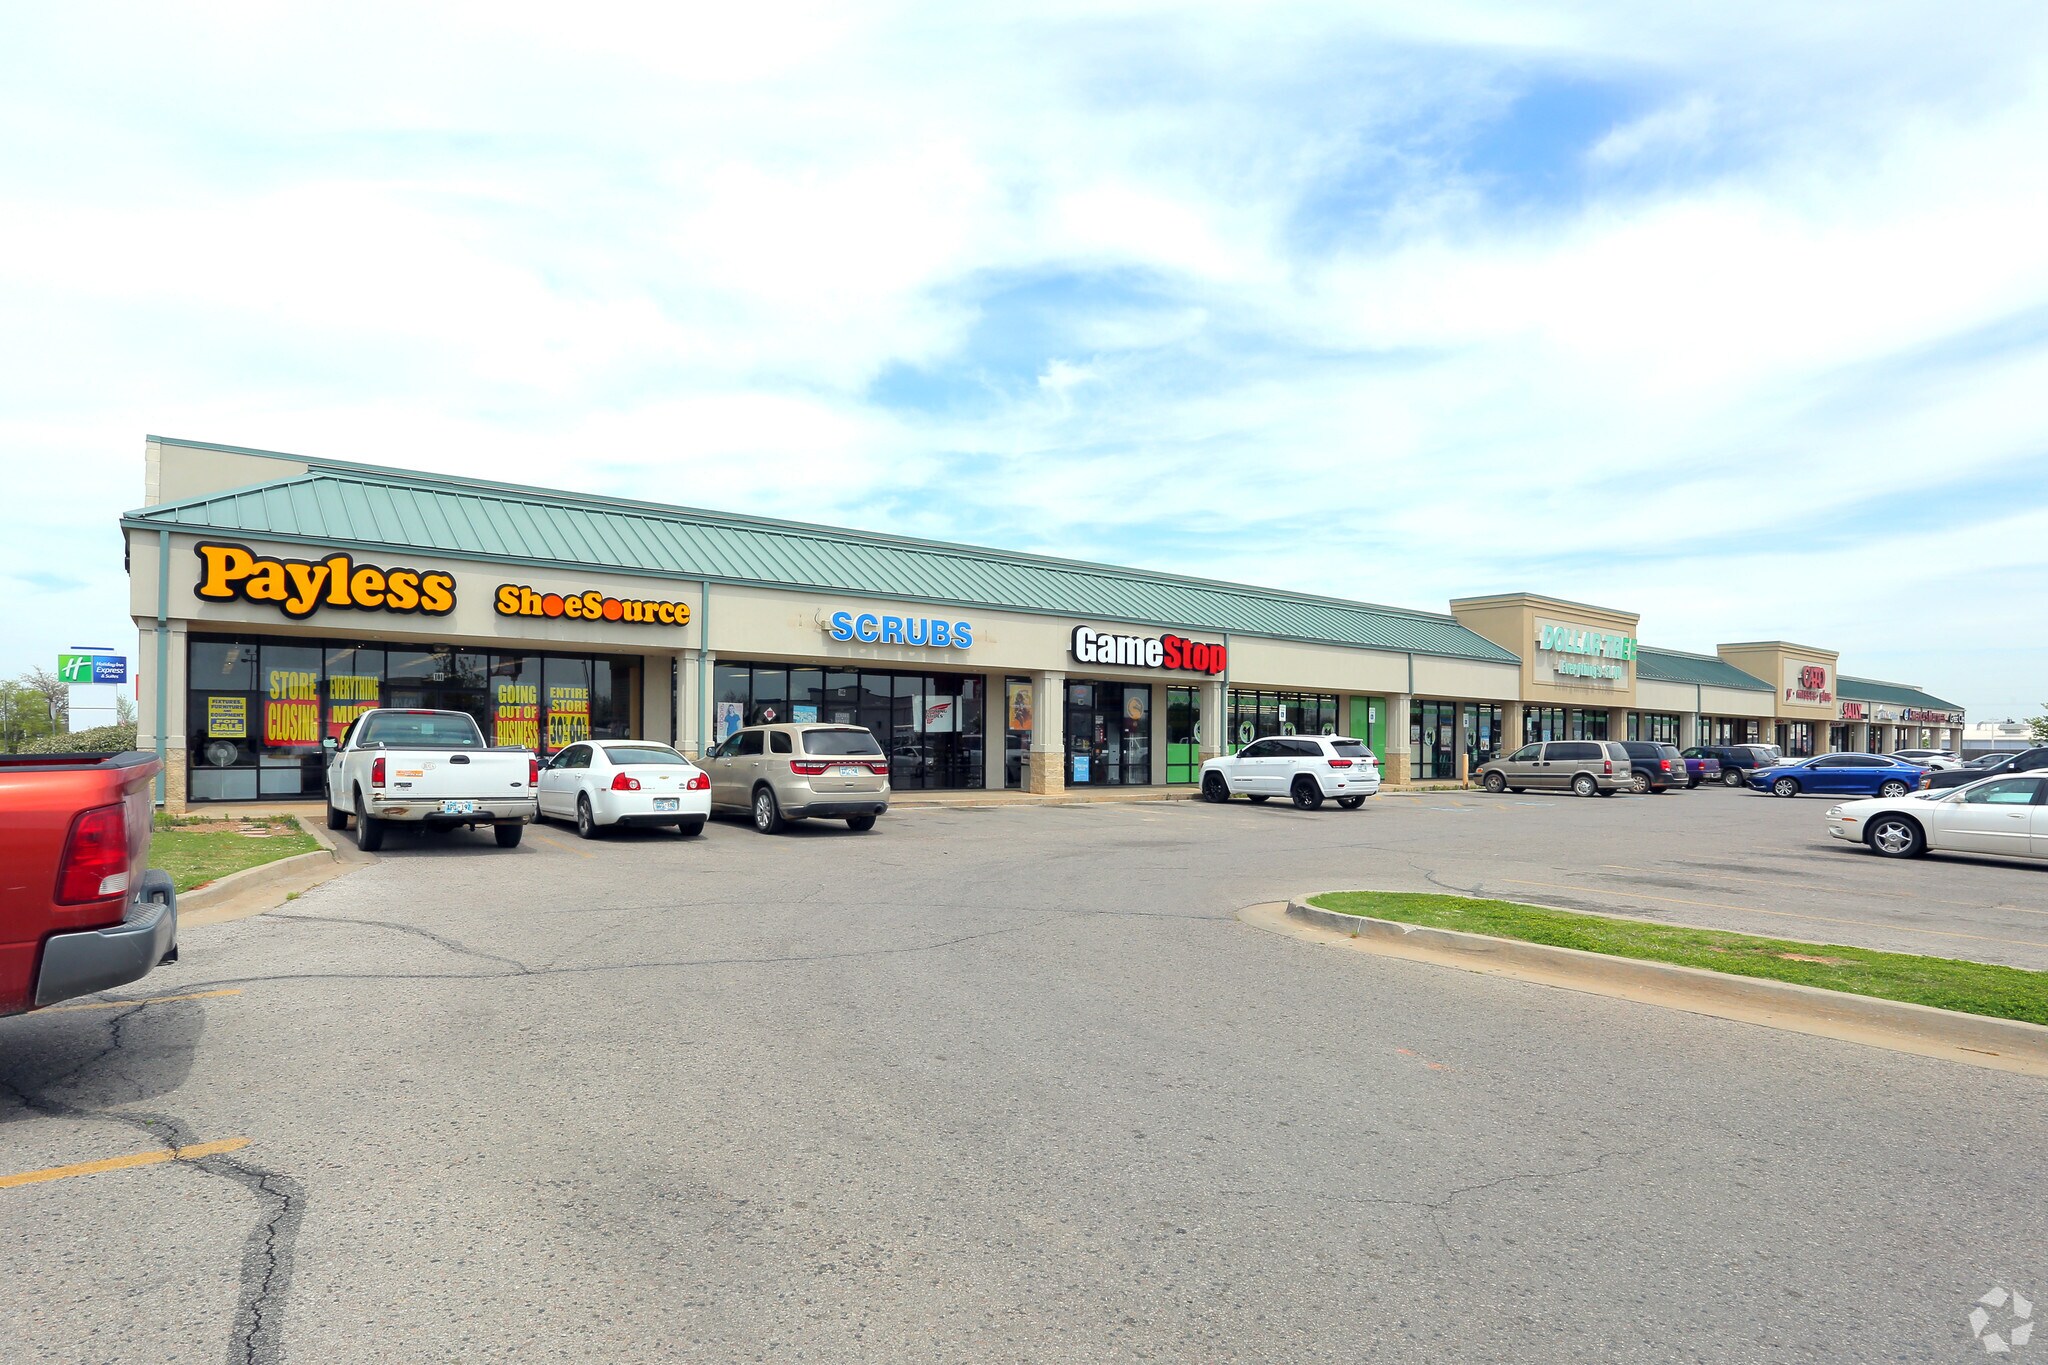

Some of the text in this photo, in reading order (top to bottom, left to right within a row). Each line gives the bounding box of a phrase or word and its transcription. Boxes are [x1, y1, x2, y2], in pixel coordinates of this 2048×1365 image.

[197, 544, 455, 616] Payless
[496, 584, 691, 626] ShoeSource
[829, 611, 974, 649] SCRUBS
[1541, 624, 1637, 660] DOLLAR TREE
[1074, 626, 1227, 675] GameStop
[269, 670, 317, 700] STORE
[329, 674, 379, 700] EVERYTHING
[1802, 665, 1826, 689] CATO
[498, 685, 537, 704] GOING
[549, 687, 588, 699] ENTIRE
[551, 699, 588, 712] STORE
[267, 703, 318, 741] CLOSING
[499, 706, 537, 719] OUT OF
[1843, 702, 1862, 719] SALLY
[212, 723, 243, 731] SALE
[497, 720, 539, 749] BUSINESS
